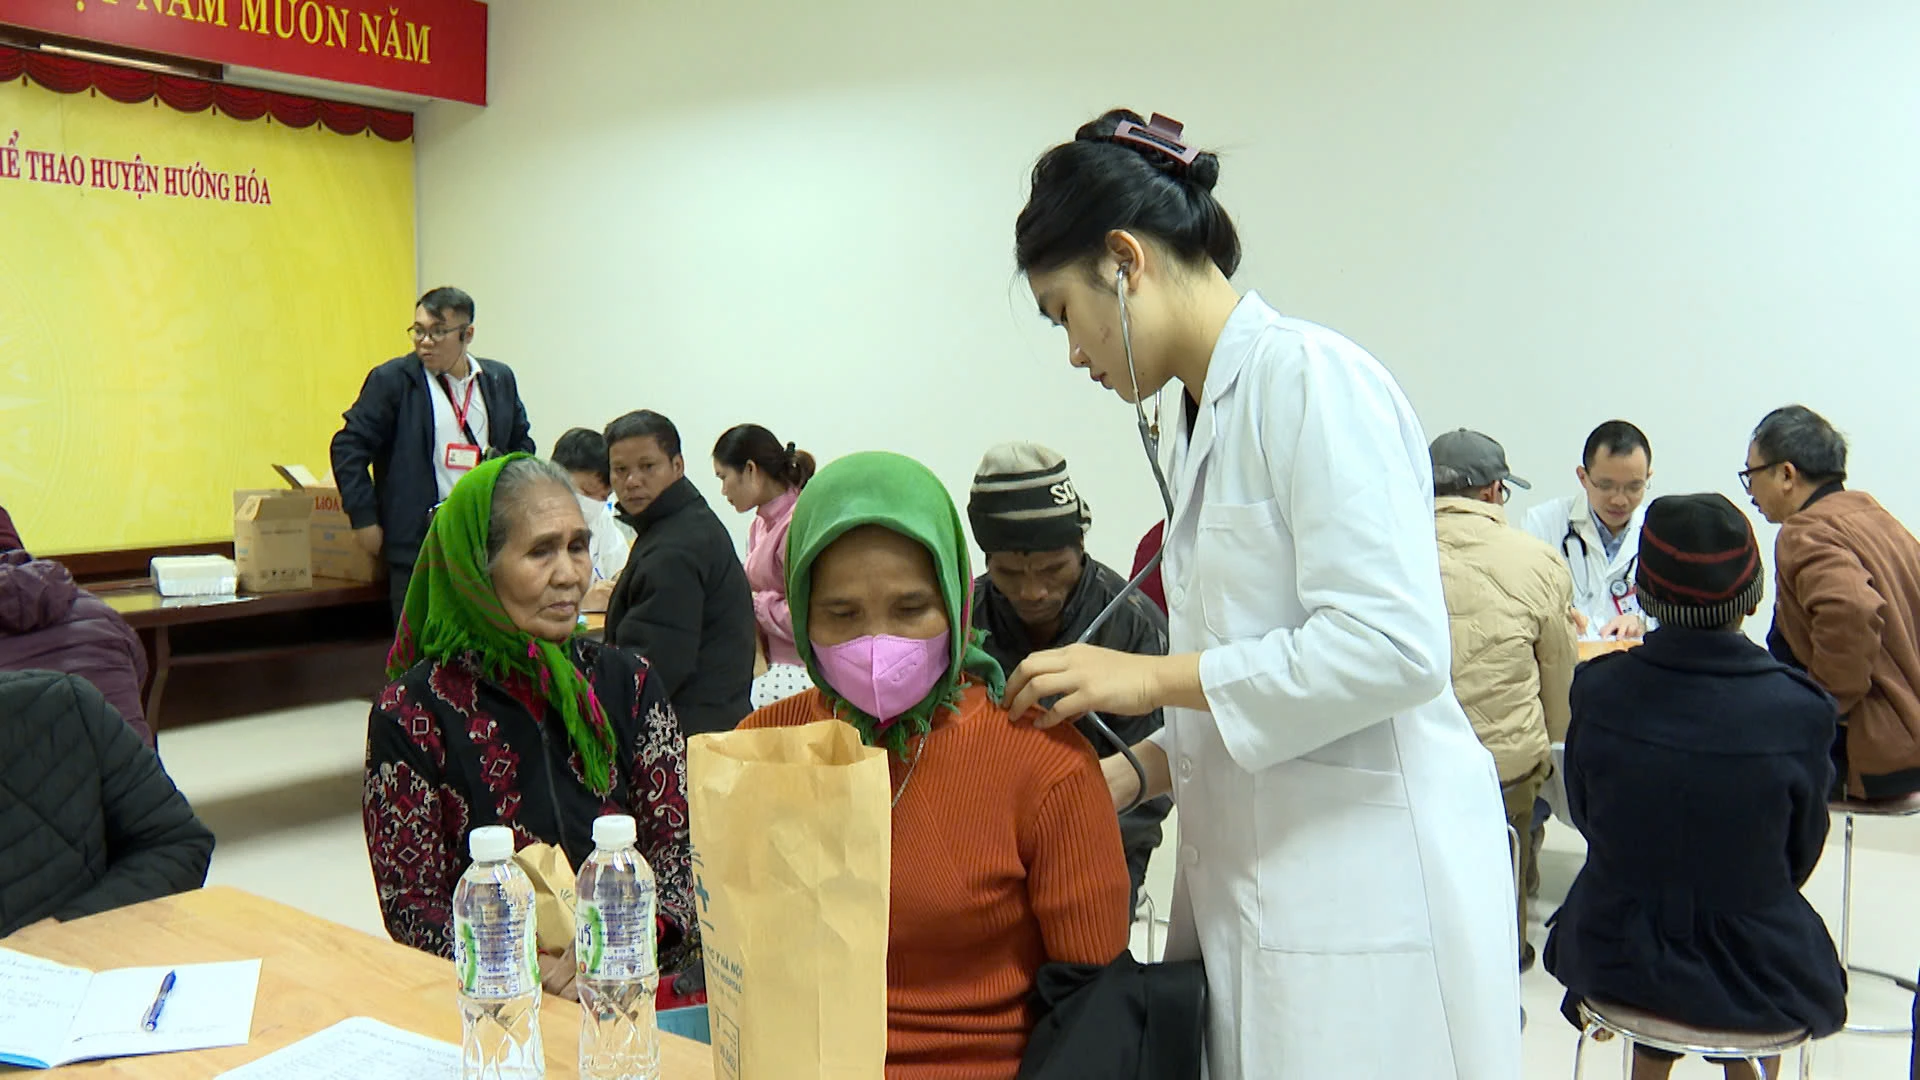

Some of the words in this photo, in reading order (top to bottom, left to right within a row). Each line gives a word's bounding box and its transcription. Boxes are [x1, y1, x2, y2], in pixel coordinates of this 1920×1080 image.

[358, 6, 431, 64] NĂM
[25, 150, 85, 186] THAO
[91, 154, 159, 200] HUYỆN
[164, 161, 230, 201] HƯỚNG
[234, 167, 271, 204] HÓA
